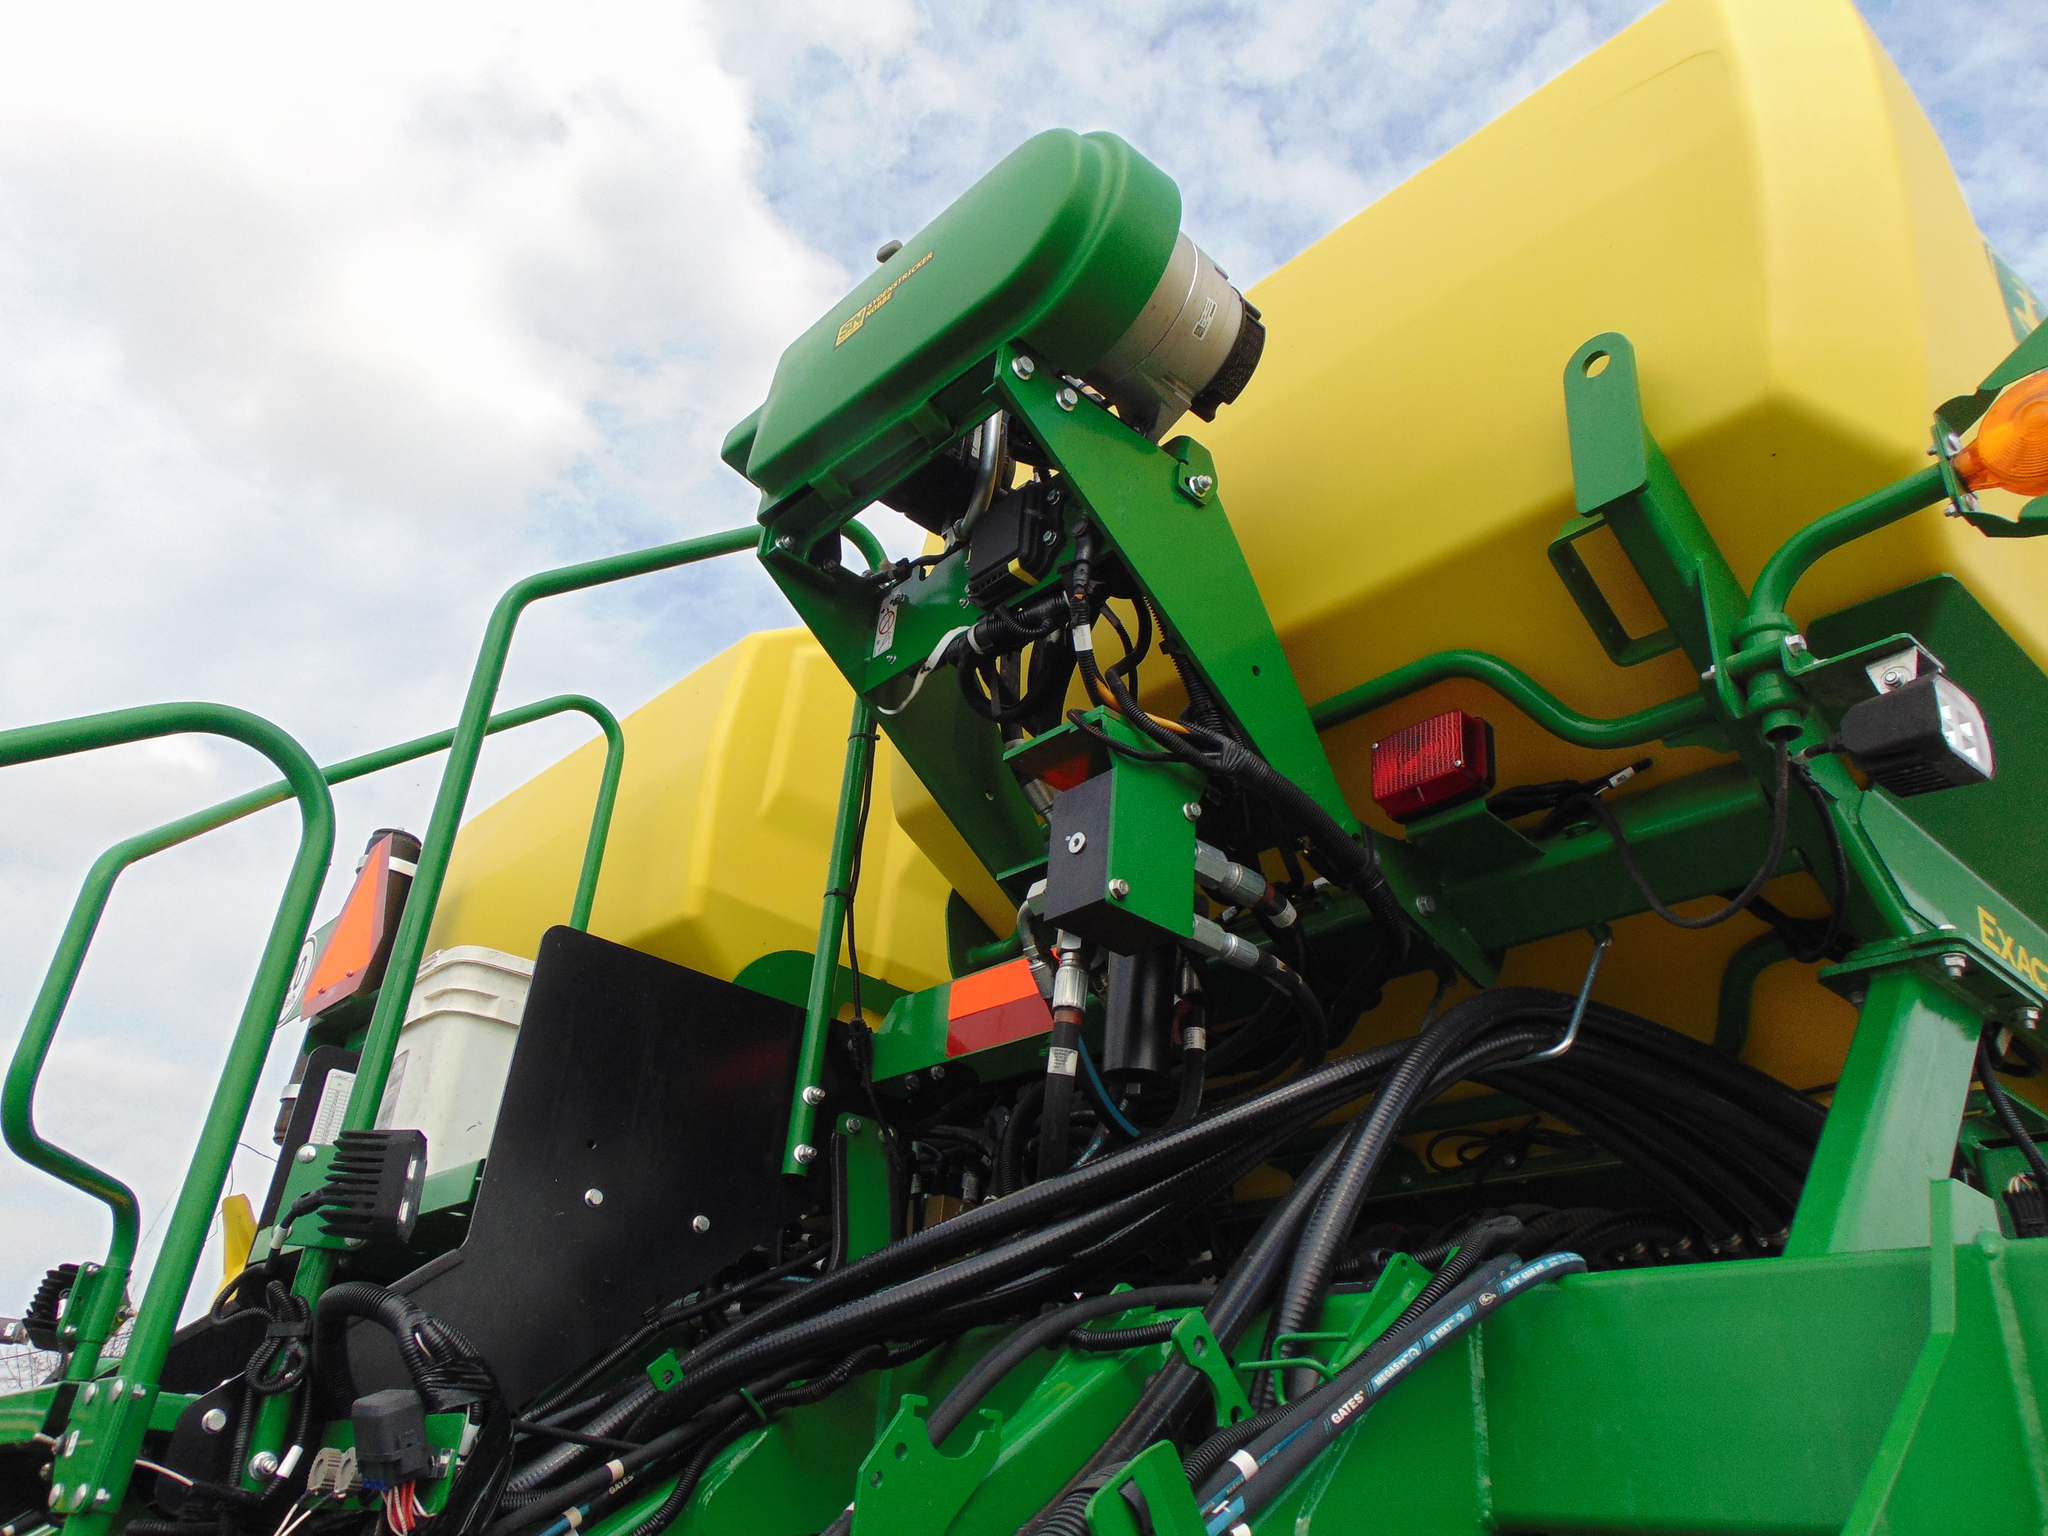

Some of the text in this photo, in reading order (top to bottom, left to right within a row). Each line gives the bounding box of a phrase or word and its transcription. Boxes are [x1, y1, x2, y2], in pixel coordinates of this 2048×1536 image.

[867, 251, 934, 310] SYDENSTRICKER
[1331, 1392, 1364, 1424] GATES
[609, 1475, 634, 1495] GATES
